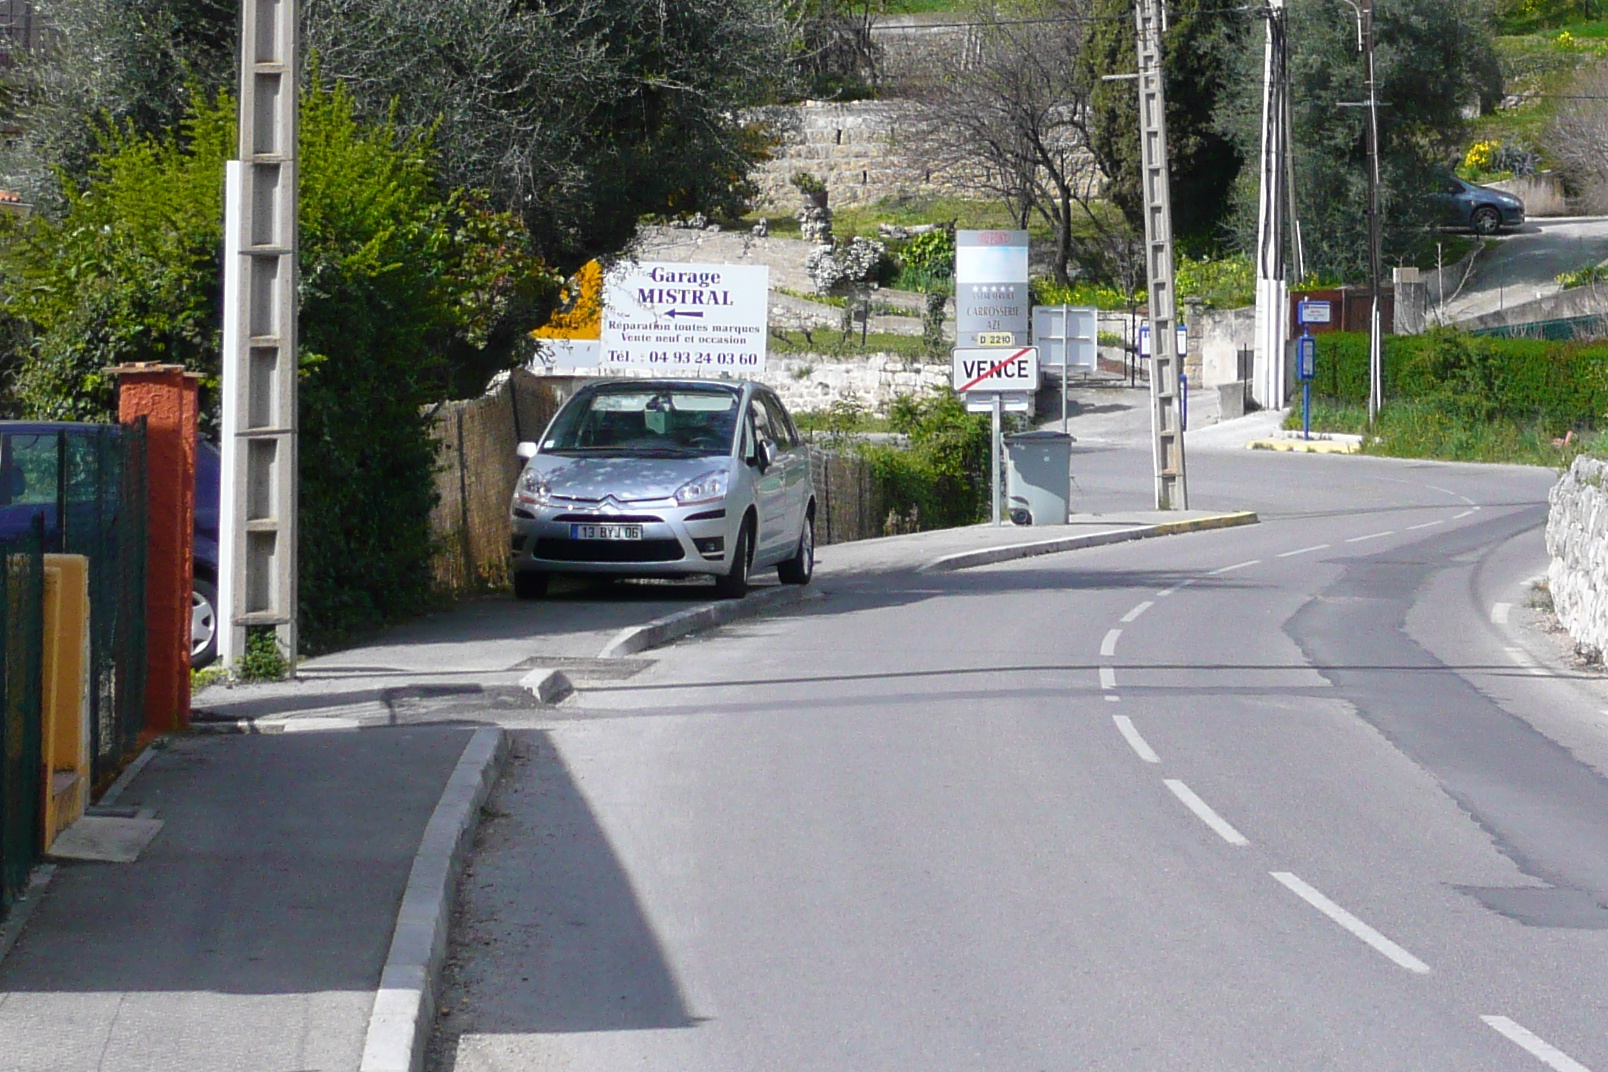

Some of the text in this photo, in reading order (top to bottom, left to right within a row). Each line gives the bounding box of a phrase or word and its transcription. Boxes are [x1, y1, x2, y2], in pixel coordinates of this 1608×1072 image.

[652, 266, 721, 287] Garage
[637, 288, 734, 306] MISTRAL
[967, 307, 1019, 317] CARROSSERIE
[608, 320, 760, 336] Réparation toutes marques
[621, 332, 747, 345] Vente neuf et occasion
[980, 335, 986, 344] D
[989, 335, 1011, 344] 2210
[608, 349, 635, 364] Tél.
[649, 351, 669, 364] 04
[673, 351, 691, 364] 93
[694, 351, 712, 365] 24
[717, 351, 735, 365] 03
[739, 352, 758, 366] 60
[963, 360, 1029, 378] VENCE
[582, 527, 639, 539] 13 BYJ 06
